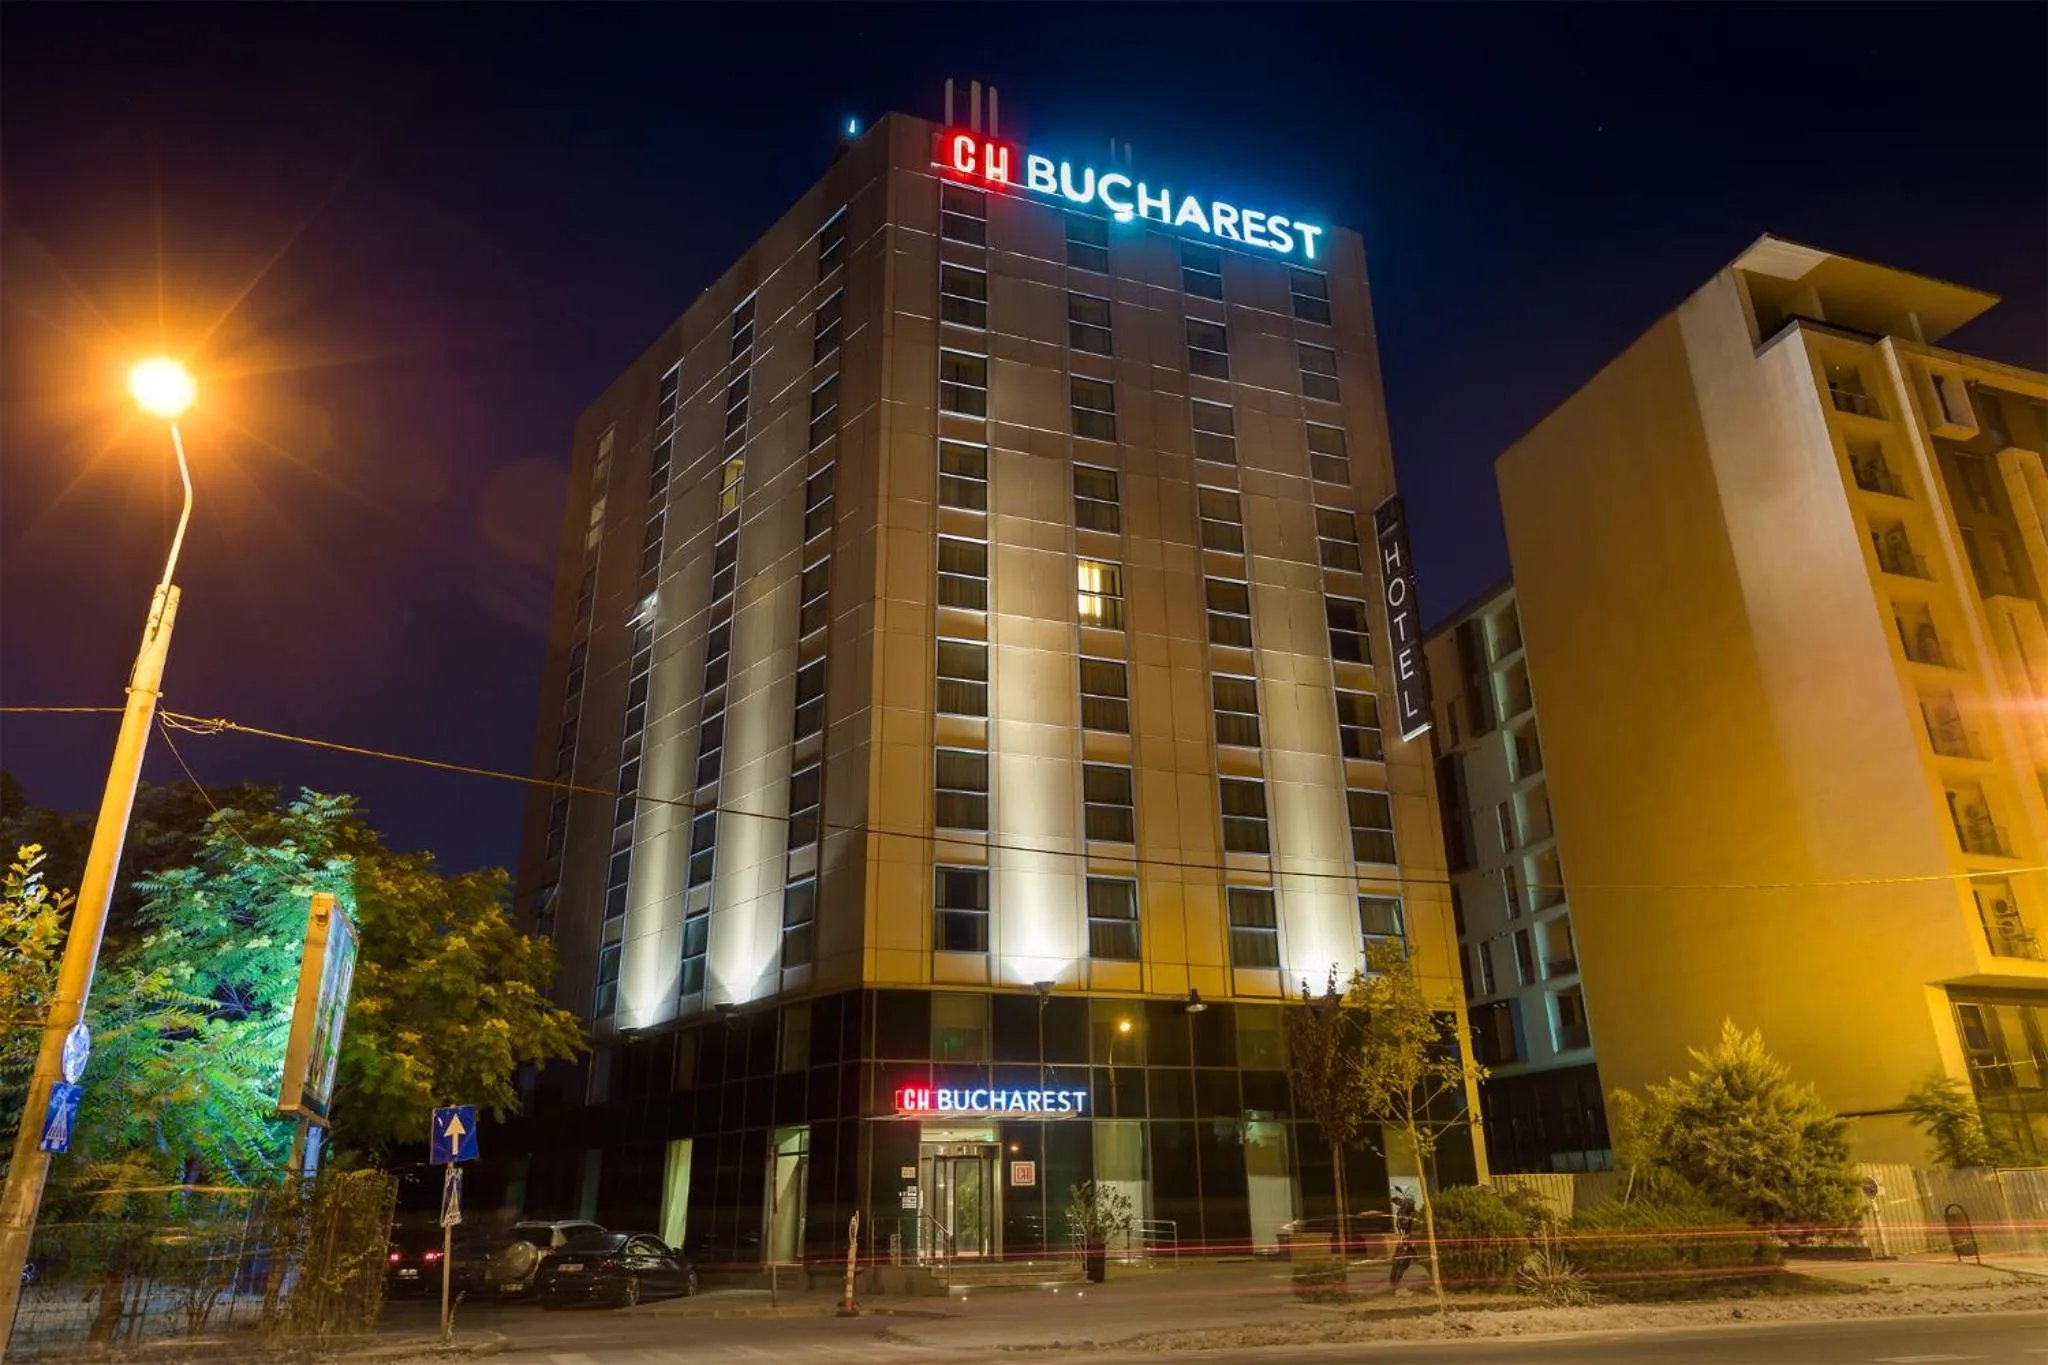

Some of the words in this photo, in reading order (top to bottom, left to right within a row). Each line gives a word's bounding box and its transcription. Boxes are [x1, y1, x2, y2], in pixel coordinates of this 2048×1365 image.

[952, 135, 1009, 182] CH
[1385, 541, 1418, 718] HOTEL
[904, 1089, 930, 1110] CH
[937, 1089, 1087, 1112] BUCHAREST
